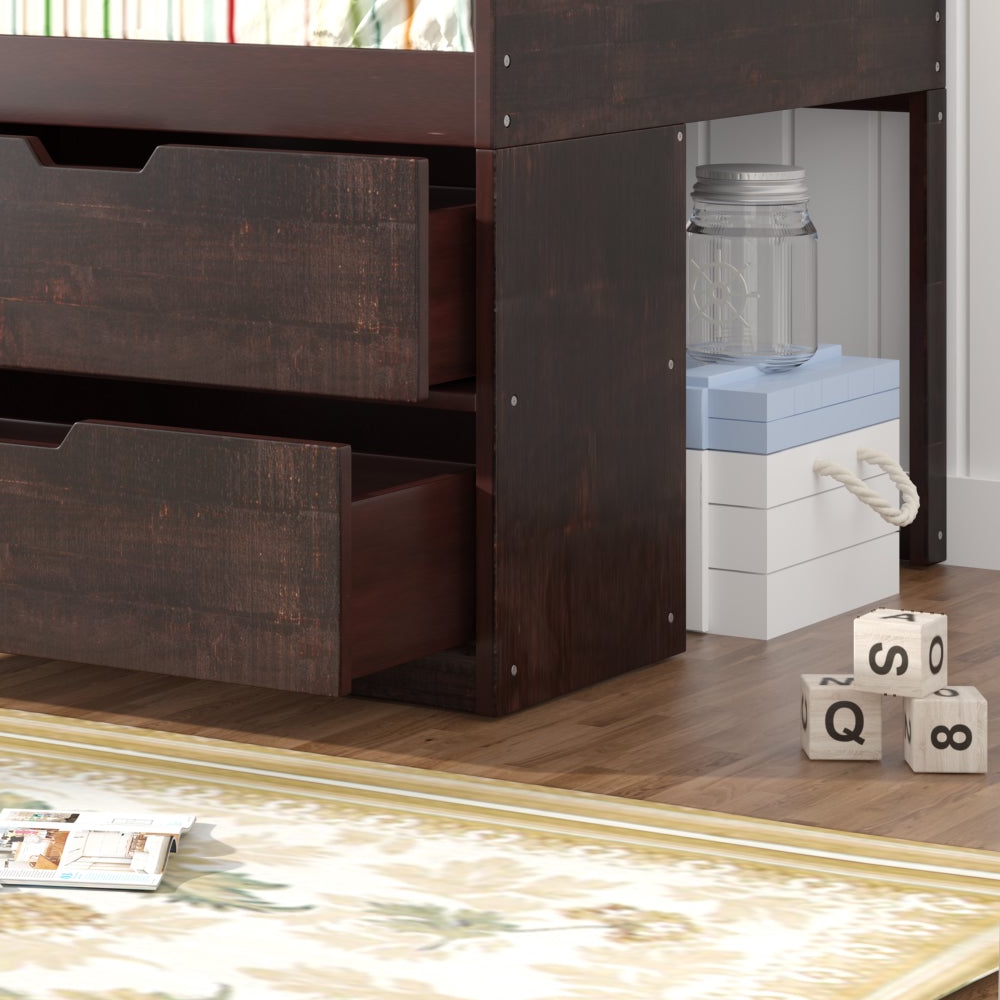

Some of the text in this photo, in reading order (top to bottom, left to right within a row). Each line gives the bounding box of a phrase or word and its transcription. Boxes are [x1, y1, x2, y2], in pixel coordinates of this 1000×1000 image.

[868, 642, 909, 676] S
[824, 700, 866, 746] Q
[930, 724, 973, 751] 8
